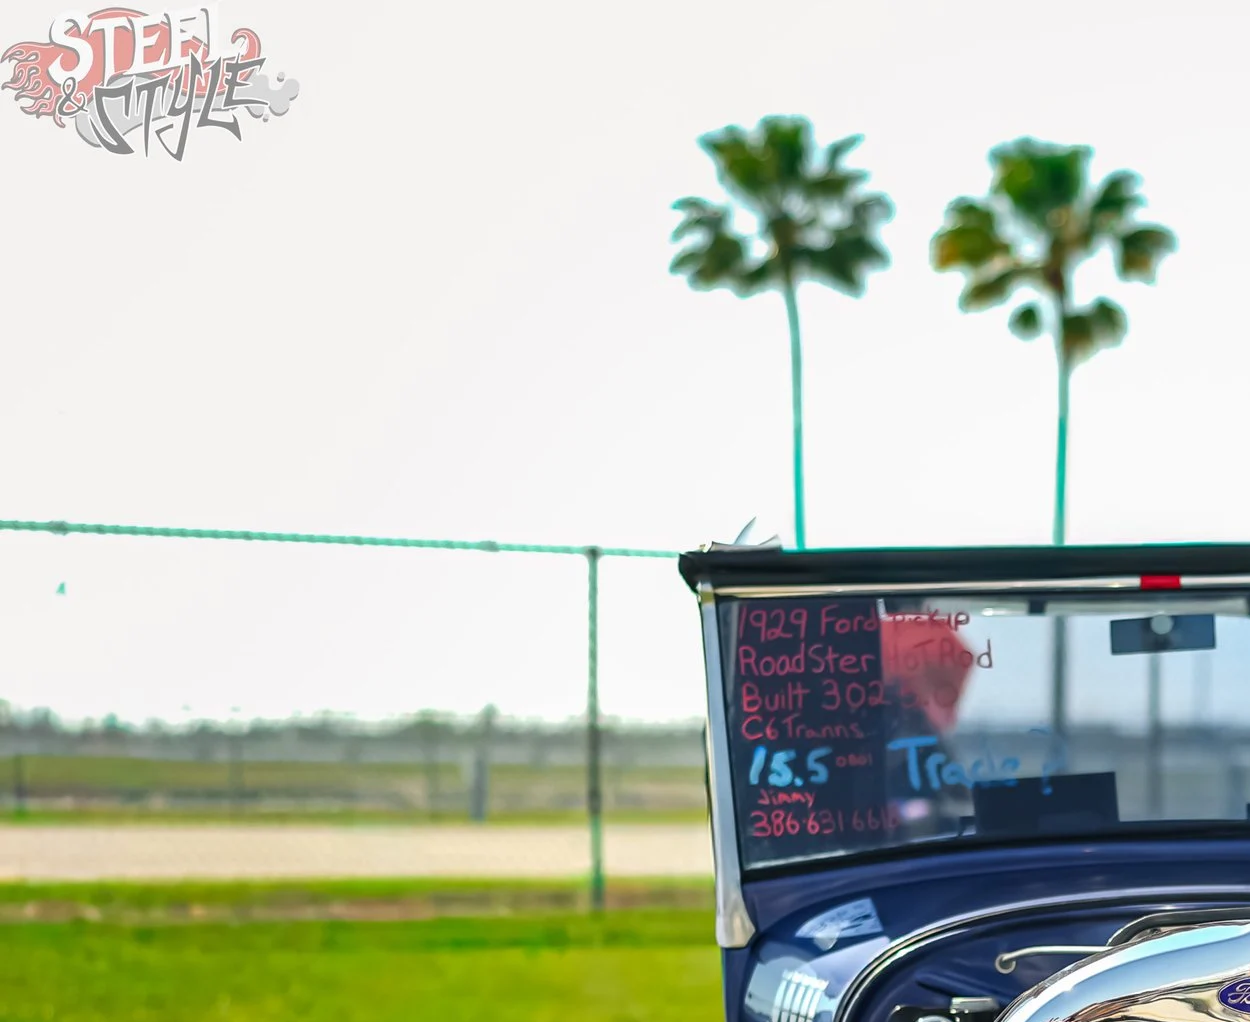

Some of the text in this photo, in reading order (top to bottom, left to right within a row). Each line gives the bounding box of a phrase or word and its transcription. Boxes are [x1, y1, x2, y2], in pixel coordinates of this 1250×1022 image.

[739, 608, 807, 642] 1929
[820, 606, 878, 635] Ford
[741, 682, 810, 713] Built
[821, 680, 887, 709] 302
[741, 717, 779, 740] C6
[749, 746, 833, 787] 15.5
[887, 735, 1021, 793] Trade
